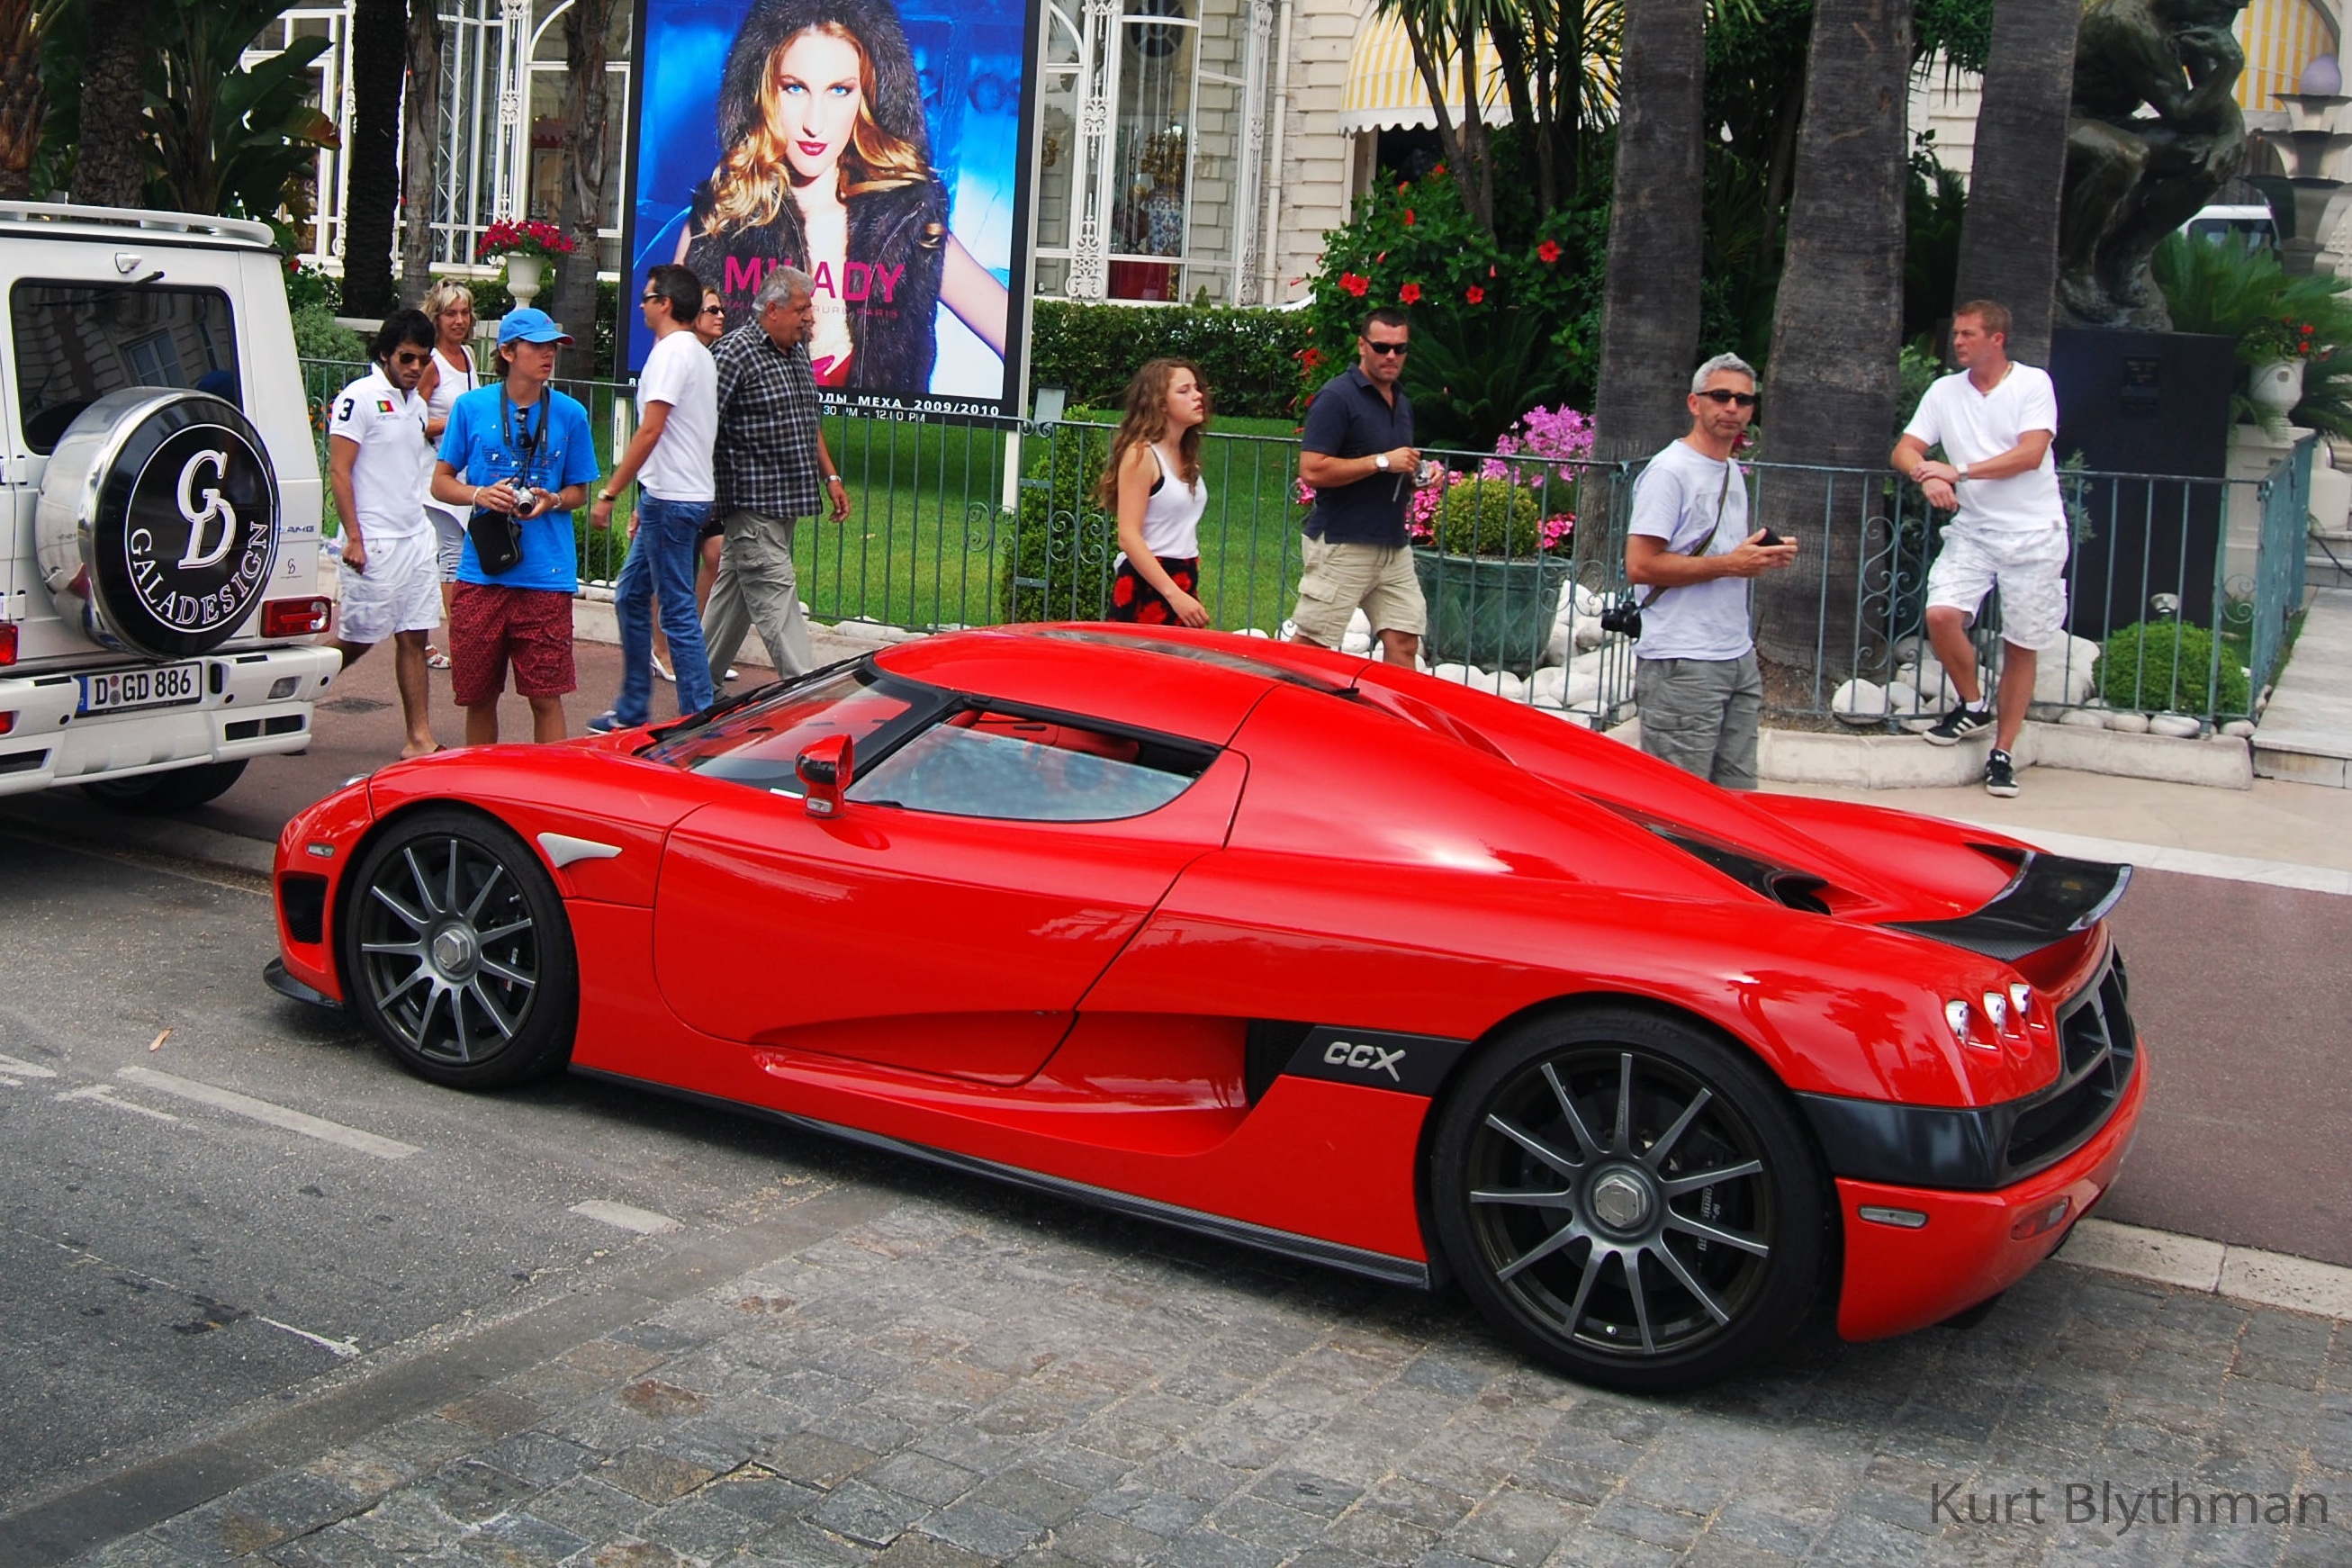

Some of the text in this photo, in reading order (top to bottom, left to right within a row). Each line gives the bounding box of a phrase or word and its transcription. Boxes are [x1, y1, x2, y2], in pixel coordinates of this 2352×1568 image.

[725, 256, 906, 303] MADY
[856, 307, 898, 319] PARIS
[338, 398, 355, 421] 3
[914, 400, 999, 417] 2009/2010
[130, 521, 268, 625] GALADESIGN
[95, 669, 192, 705] D GD 886
[1323, 1041, 1406, 1082] CCX
